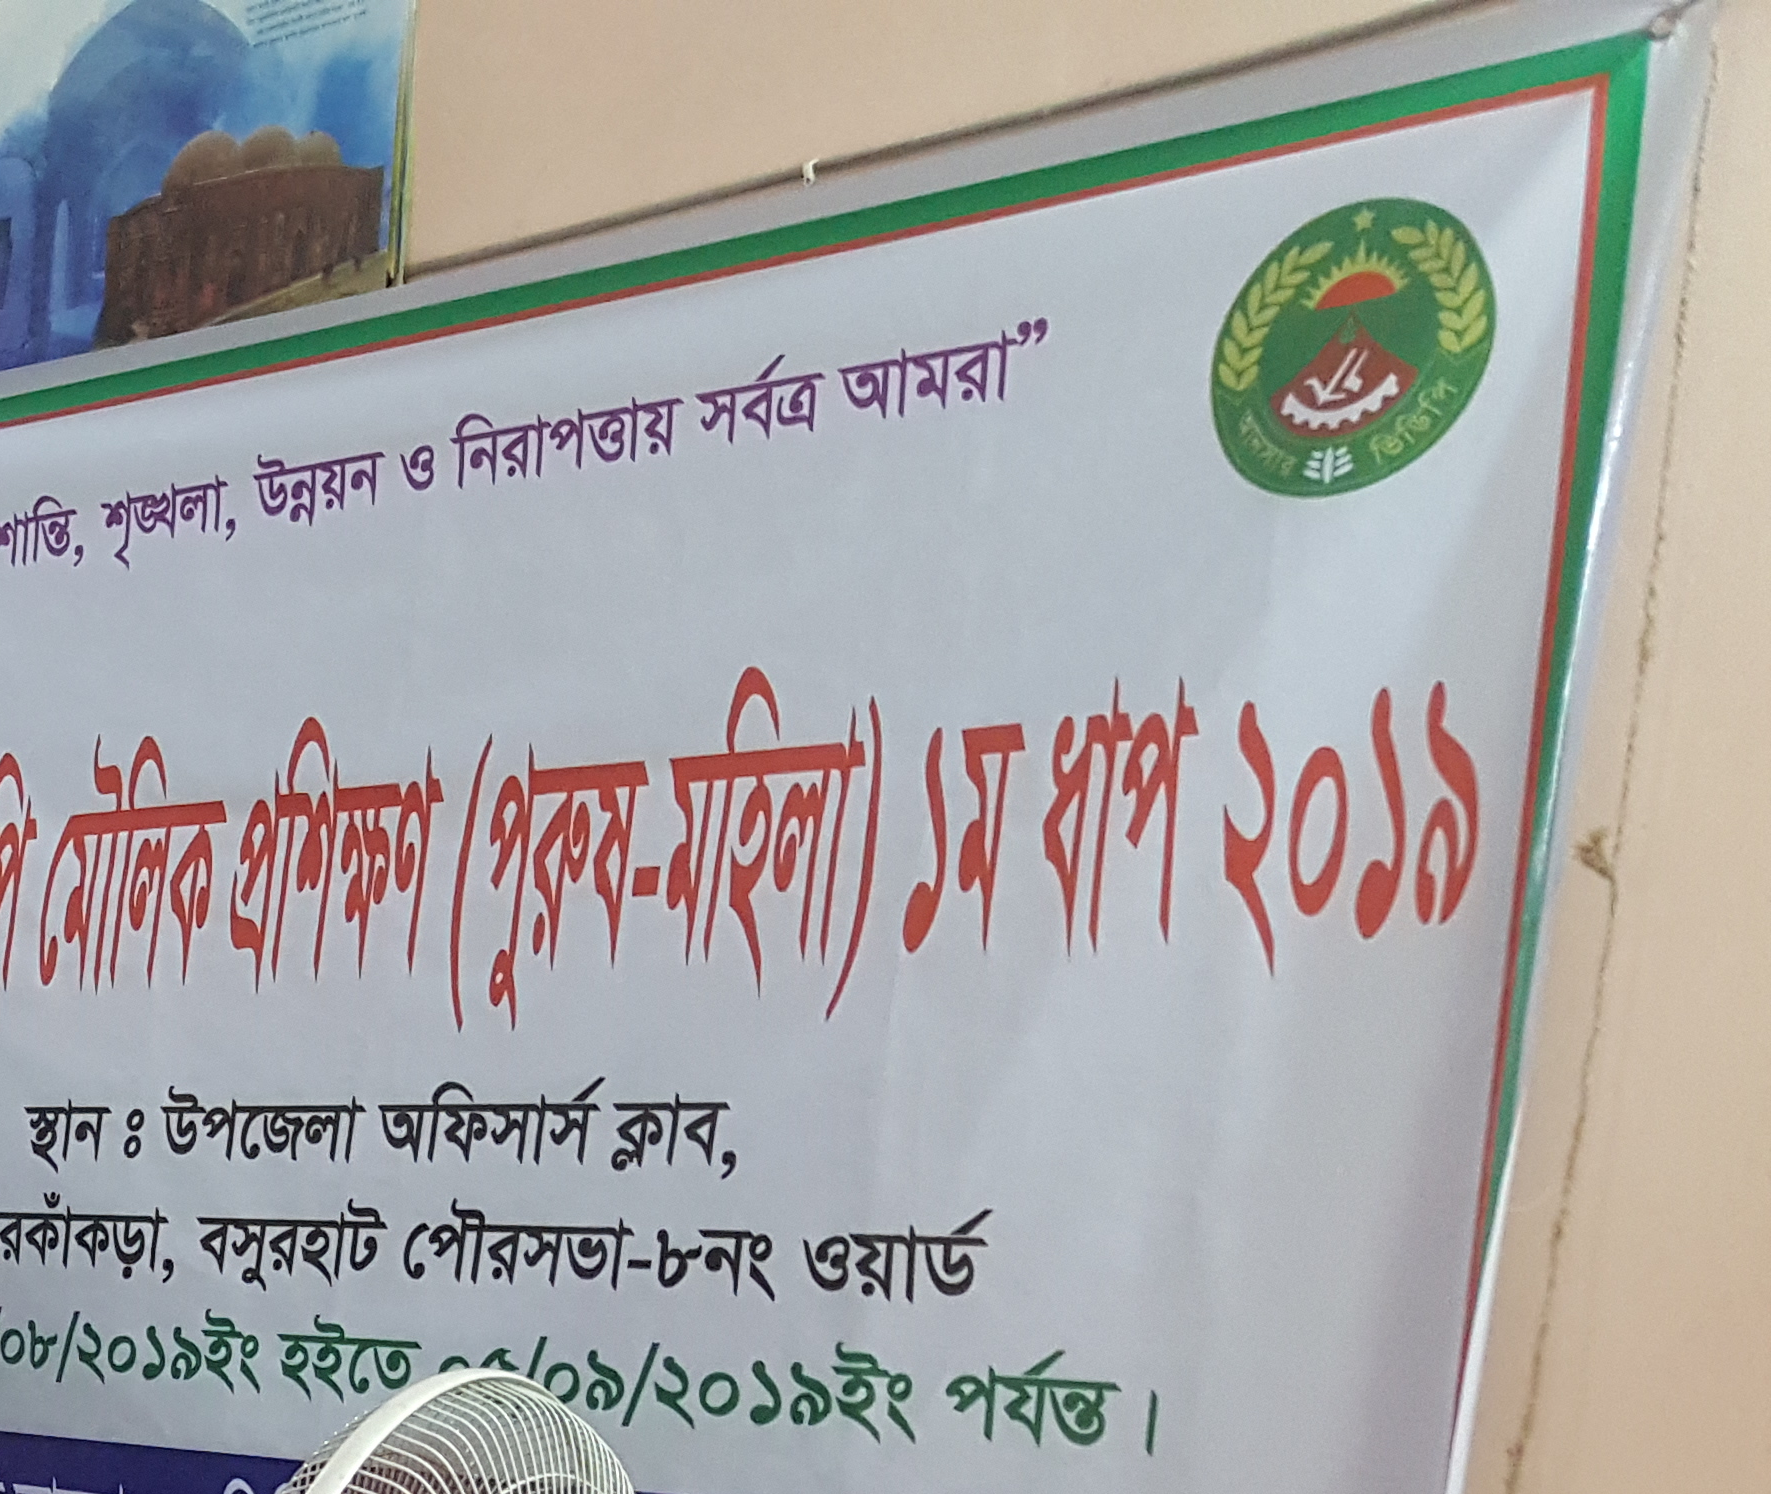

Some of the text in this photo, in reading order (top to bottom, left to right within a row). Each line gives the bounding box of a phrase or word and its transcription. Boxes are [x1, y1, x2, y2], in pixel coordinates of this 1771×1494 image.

[100, 474, 237, 570] শৃঙ্খলা,
[253, 452, 385, 527] উন্নয়ন
[400, 445, 435, 491] ও
[449, 396, 685, 489] নিরাপত্তায়
[696, 354, 827, 445] সর্বত্র
[839, 317, 1049, 419] আমরা”
[39, 732, 228, 997] মৌলিক
[228, 715, 445, 996] প্রশিক্ষণ
[449, 665, 883, 1034] (পুরুষ-মহিলা)
[902, 723, 1027, 954] ১ম
[1042, 674, 1201, 959] ধাপ
[1222, 679, 1481, 978] ২০১৯
[23, 1098, 111, 1173] স্থান
[159, 1084, 367, 1165] উপজেলা
[378, 1075, 608, 1166] অফিসার্স
[610, 1092, 738, 1182] ক্লাব,
[196, 1196, 388, 1292] বসুরহাট
[802, 1208, 995, 1304] ওয়ার্ড
[276, 1313, 423, 1404] হইতে
[945, 1348, 1122, 1448] পর্যন্ত
